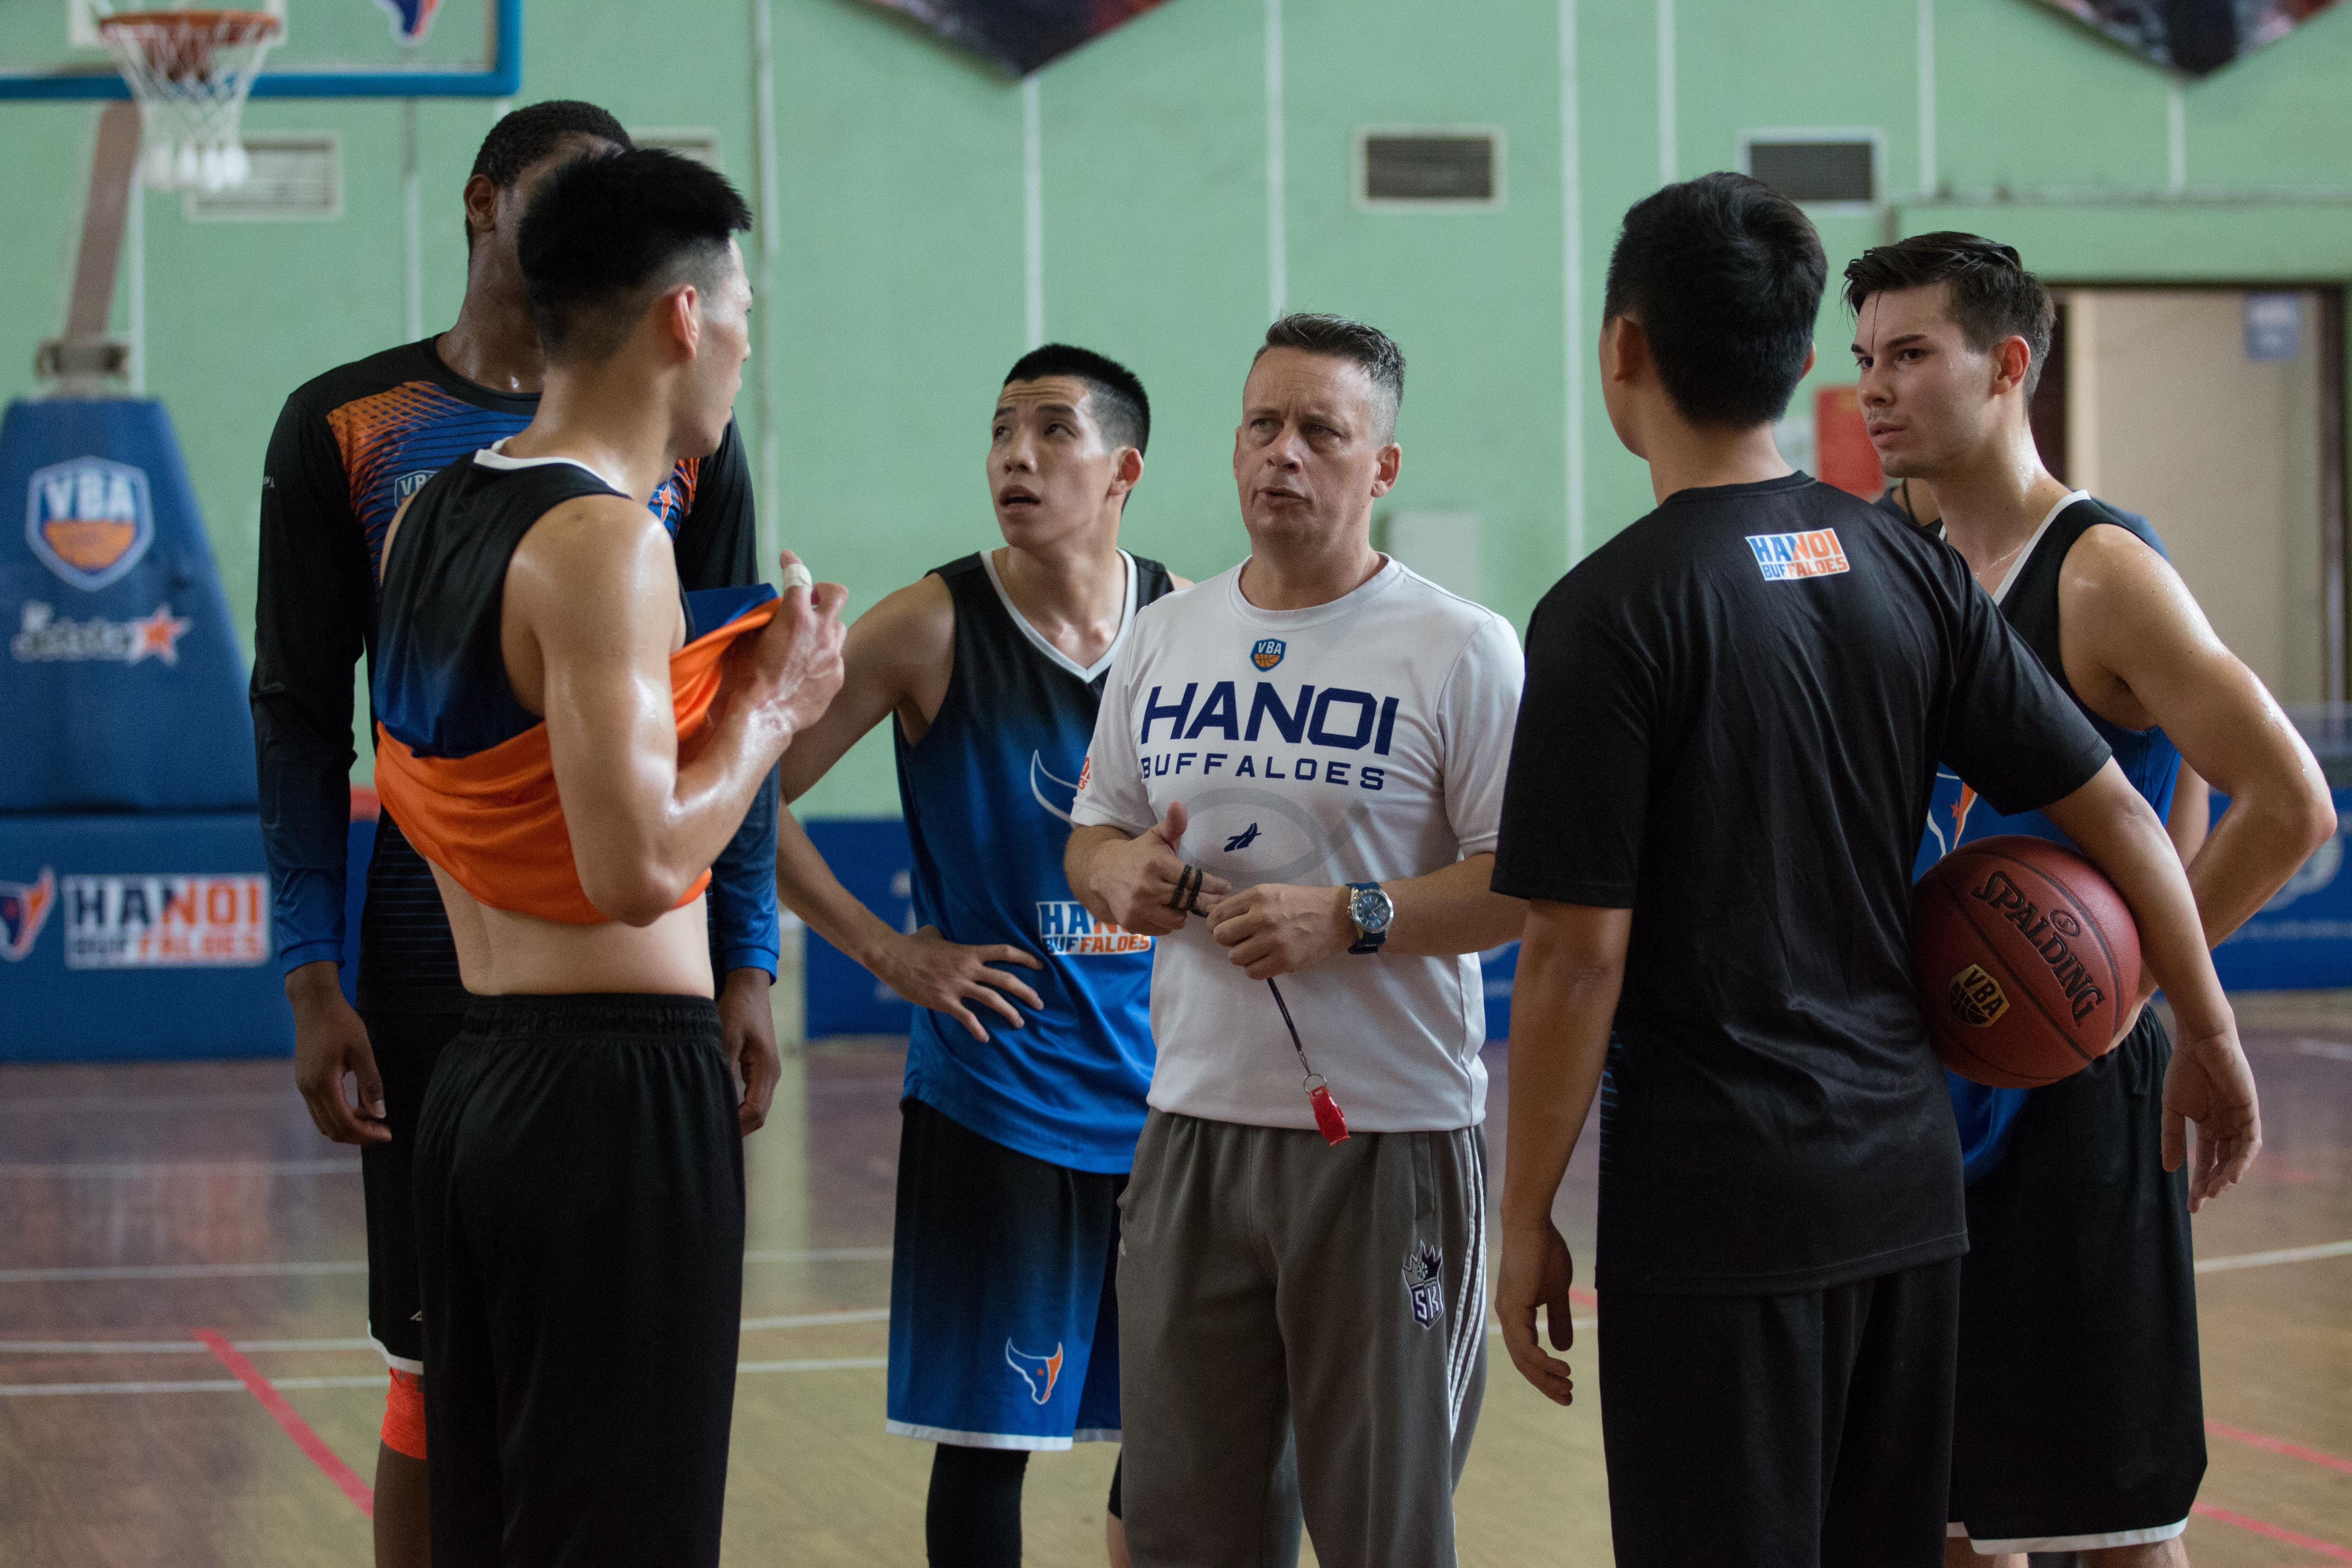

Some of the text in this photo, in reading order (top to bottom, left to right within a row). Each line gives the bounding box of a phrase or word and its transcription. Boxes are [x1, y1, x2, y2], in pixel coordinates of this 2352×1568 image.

[42, 470, 135, 521] VBA
[400, 474, 434, 495] VB
[1749, 530, 1842, 562] HANOI
[1762, 557, 1848, 578] BUFFALOES
[1258, 641, 1282, 655] VBA
[1140, 681, 1400, 756] HANOI
[1141, 753, 1385, 790] BUFFALOES
[74, 884, 259, 927] HANOI
[1972, 871, 2106, 1022] SPALDING
[1963, 968, 2004, 1018] VBA
[1415, 1286, 1439, 1320] SK
